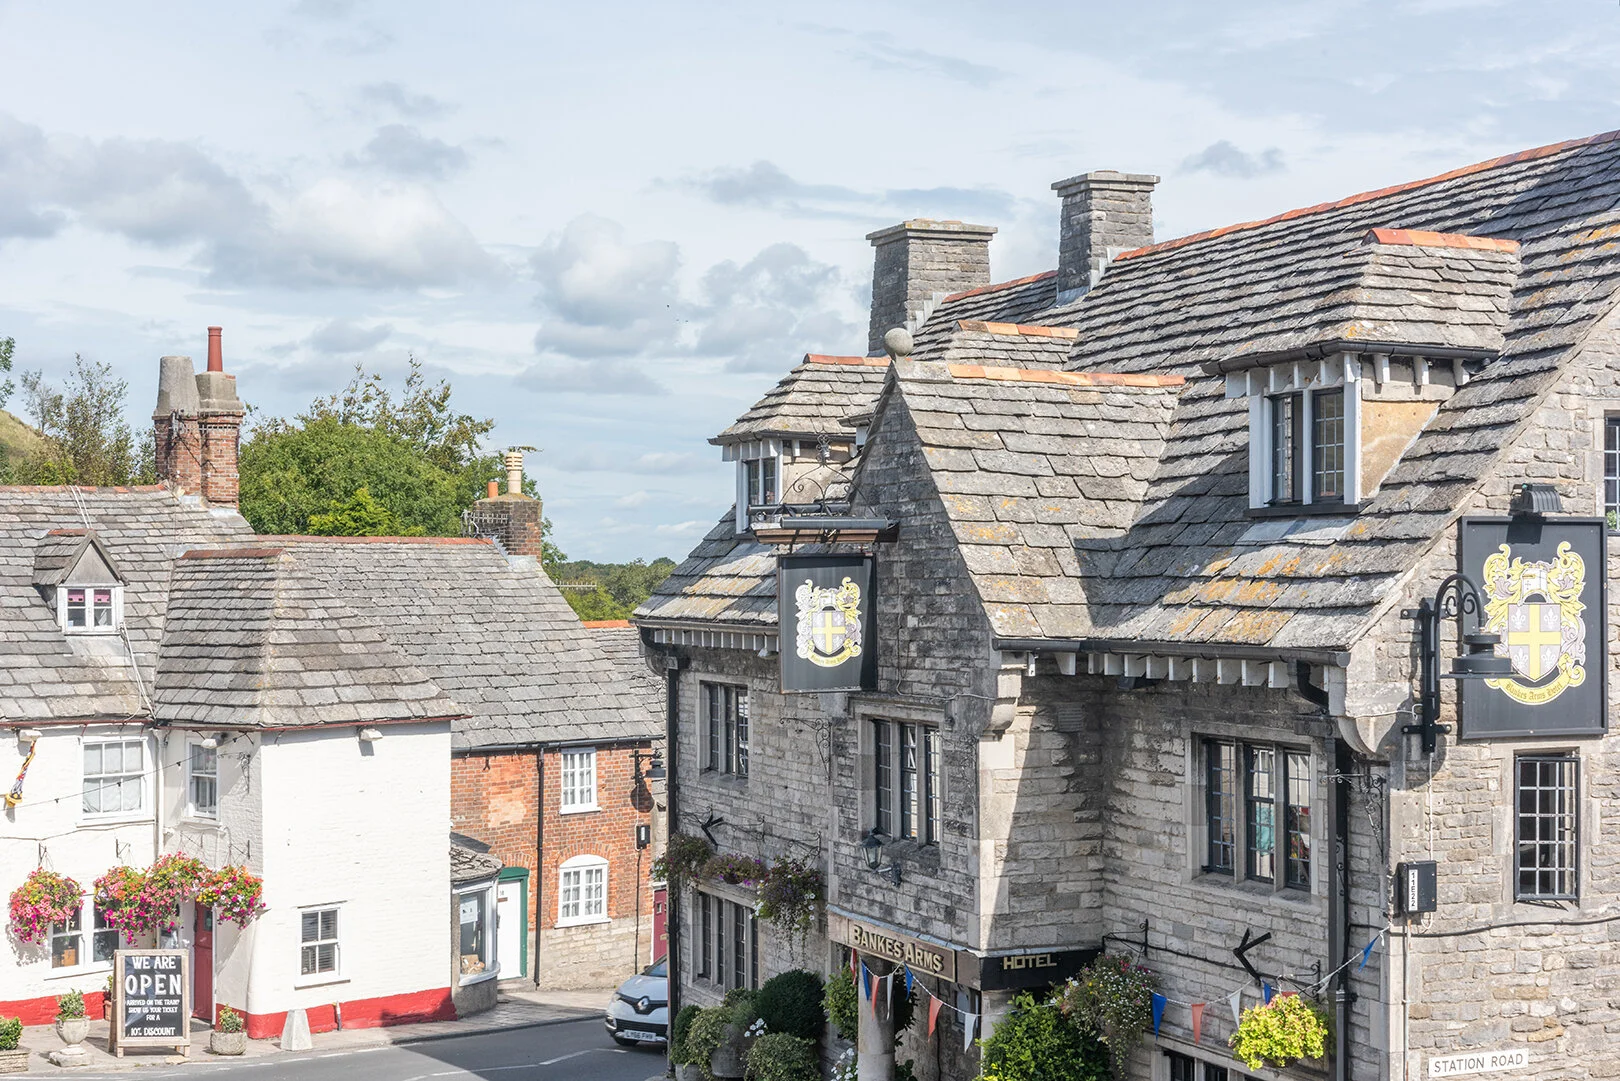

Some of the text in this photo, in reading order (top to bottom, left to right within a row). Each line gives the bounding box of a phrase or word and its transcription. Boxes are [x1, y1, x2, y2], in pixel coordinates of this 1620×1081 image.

[131, 956, 176, 969] WE ARE
[904, 942, 944, 972] ARMS
[1003, 954, 1058, 970] HOTEL
[125, 974, 182, 995] OPEN
[143, 1027, 176, 1036] DISCOUNT
[1434, 1053, 1524, 1073] STATION ROAD
